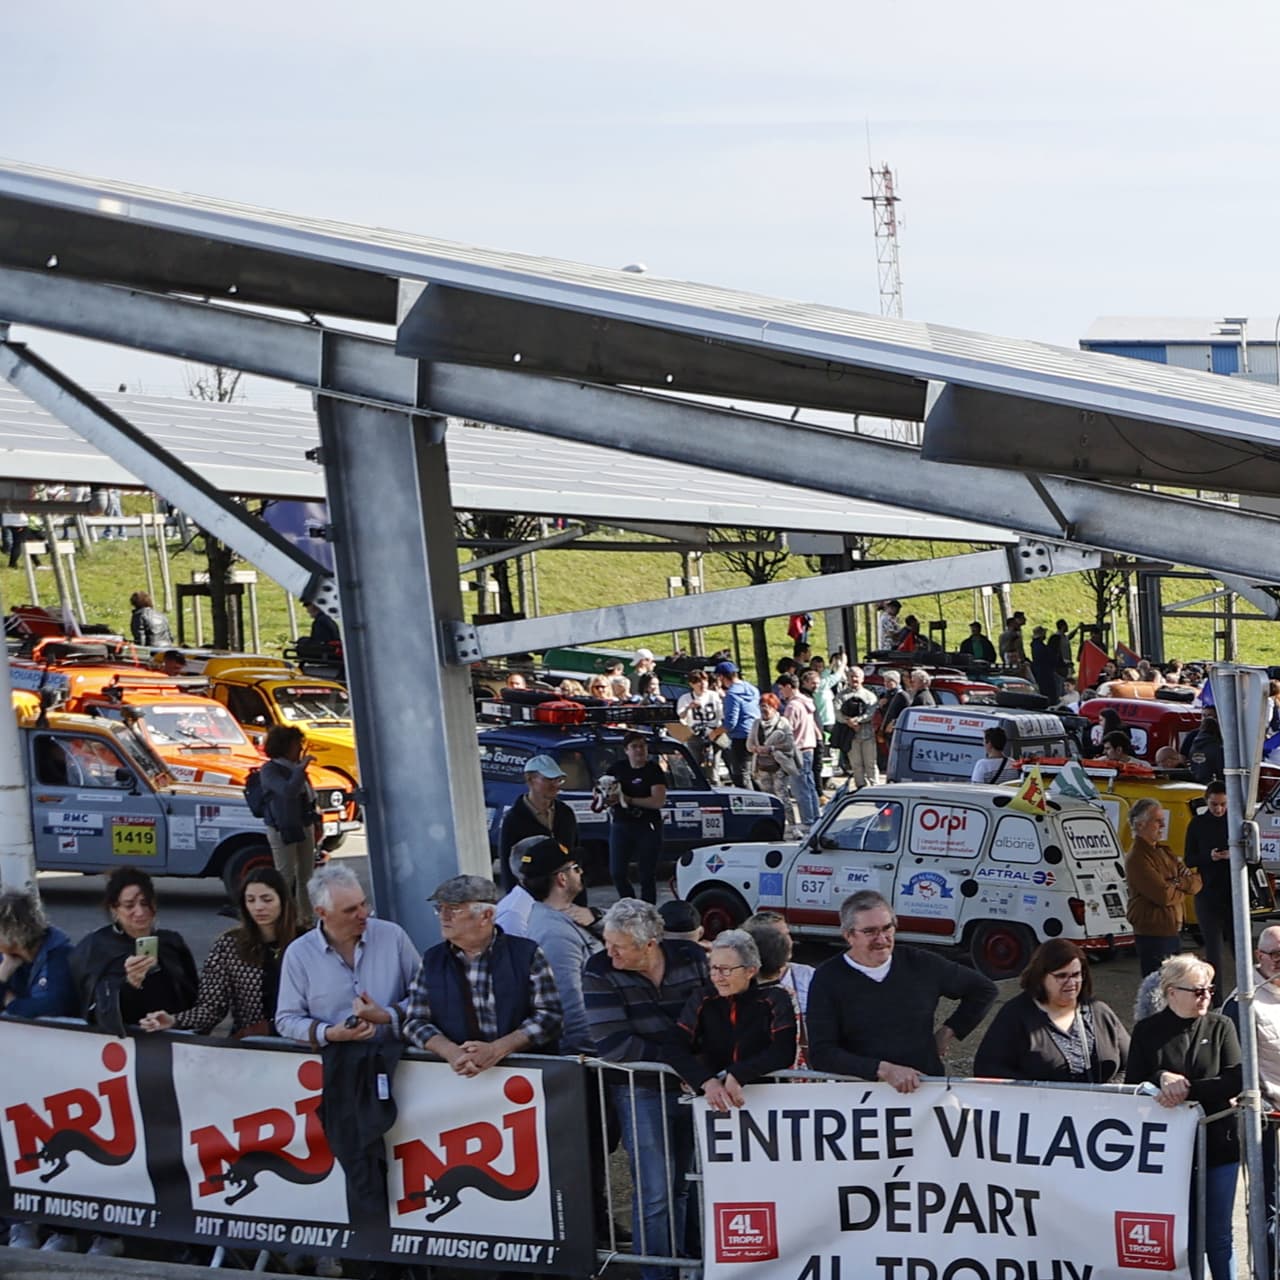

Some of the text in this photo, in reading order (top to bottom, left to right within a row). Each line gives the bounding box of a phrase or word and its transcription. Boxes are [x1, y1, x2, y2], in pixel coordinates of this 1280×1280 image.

[63, 812, 90, 823] RMC
[706, 818, 721, 830] 802
[919, 808, 968, 836] Orpi
[114, 830, 154, 845] 1419
[847, 872, 869, 883] RMC
[977, 868, 1031, 881] AFTRAL
[801, 880, 825, 894] 637
[706, 1091, 1169, 1175] ENTRÉE VILLAGE
[14, 1193, 40, 1213] HIT
[44, 1196, 99, 1220] MUSIC
[103, 1204, 146, 1226] ONLY
[838, 1165, 1041, 1237] DÉPART
[195, 1216, 224, 1236] HIT
[227, 1219, 287, 1243] MUSIC
[291, 1227, 339, 1248] ONLY
[728, 1214, 760, 1235] 4L
[728, 1235, 764, 1244] TROPHY
[1128, 1224, 1158, 1245] 4L
[391, 1234, 424, 1253] HIT
[426, 1238, 489, 1260] MUSIC
[493, 1243, 543, 1264] ONLY
[1128, 1244, 1162, 1254] TROPHY
